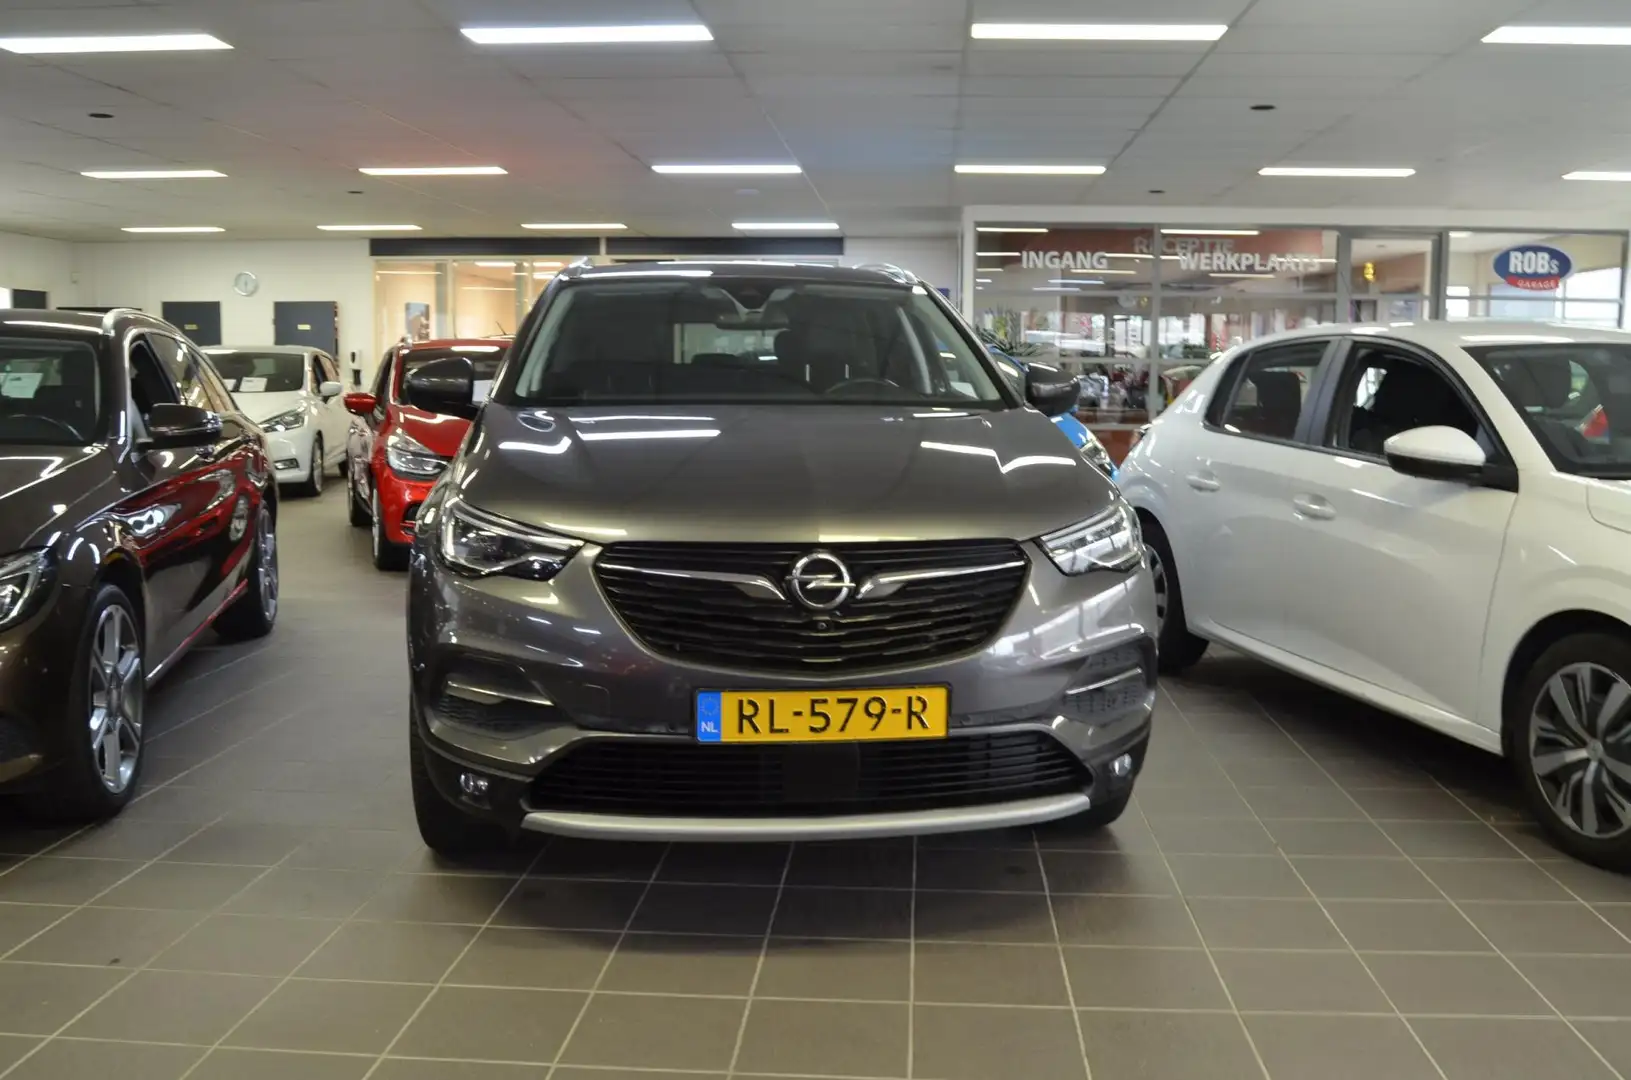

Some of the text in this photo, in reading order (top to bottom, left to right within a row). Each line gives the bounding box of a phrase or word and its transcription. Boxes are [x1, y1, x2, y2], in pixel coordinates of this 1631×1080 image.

[1021, 250, 1108, 270] INGANG
[1179, 252, 1321, 272] WERKPLAATS
[737, 695, 931, 735] RL-579-R
[700, 720, 719, 734] NL
